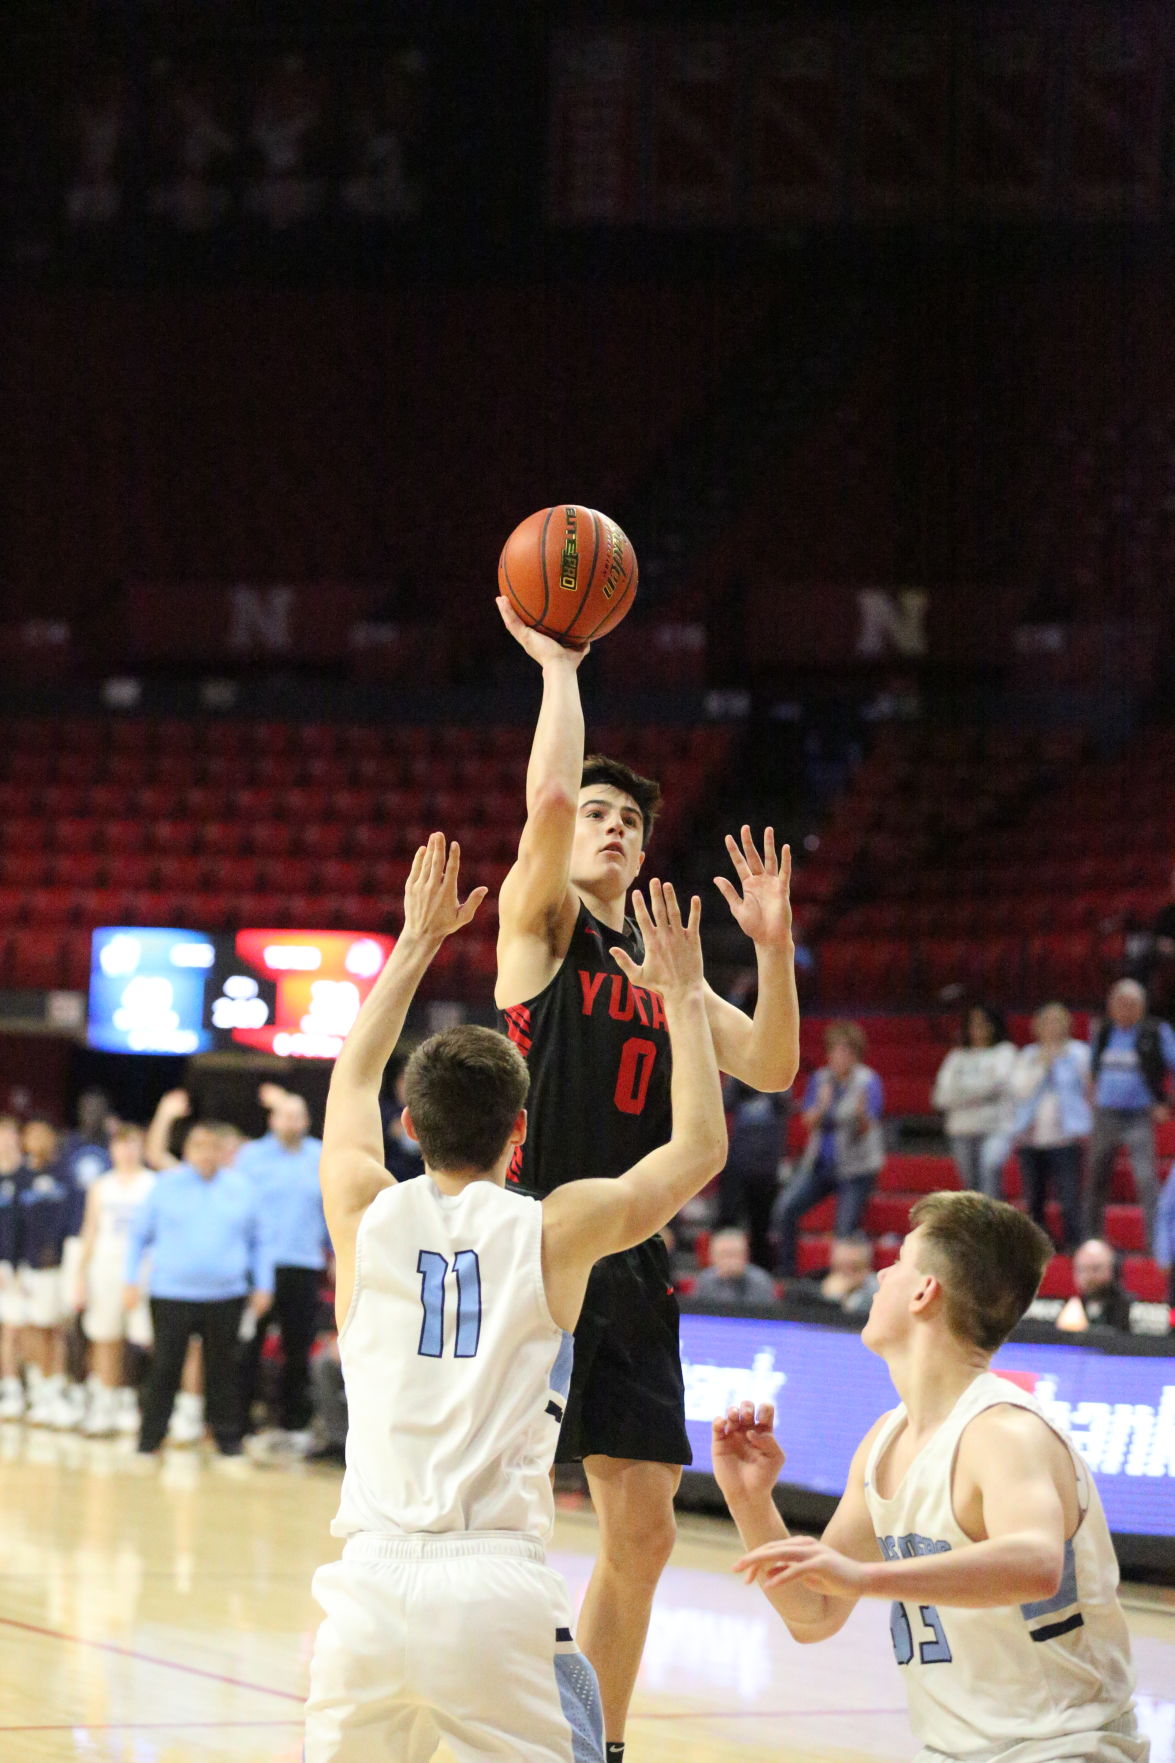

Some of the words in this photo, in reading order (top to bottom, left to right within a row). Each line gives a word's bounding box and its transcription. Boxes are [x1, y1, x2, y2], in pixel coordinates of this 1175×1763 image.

[565, 507, 577, 555] ELITE
[561, 556, 578, 588] PRO
[857, 588, 928, 656] N
[614, 1037, 657, 1115] 0
[416, 1249, 482, 1358] 11
